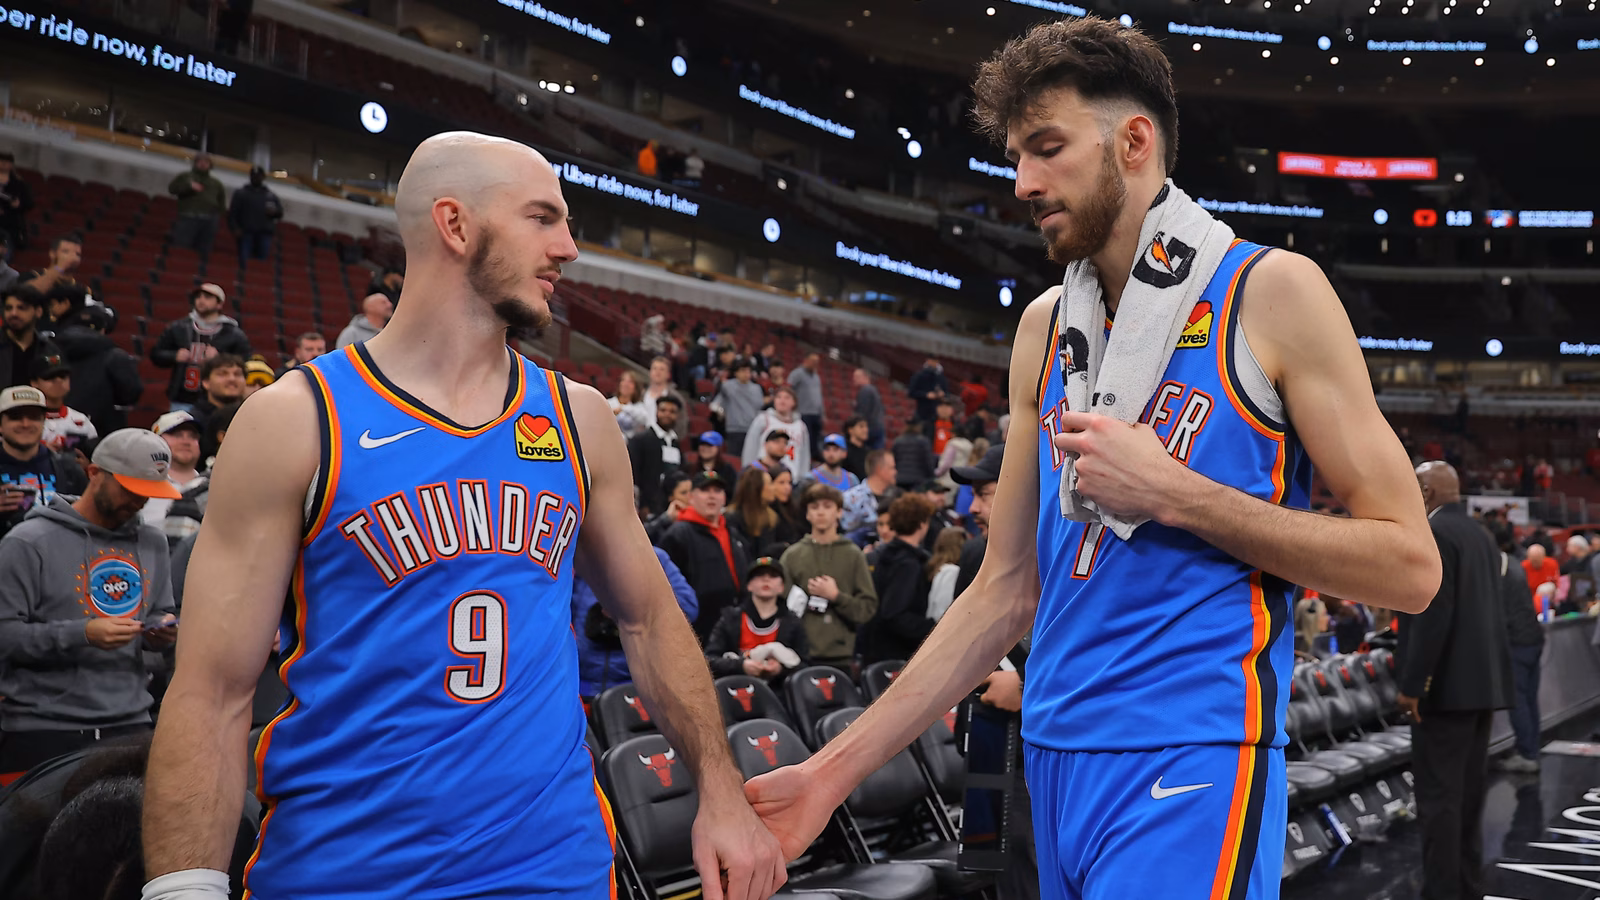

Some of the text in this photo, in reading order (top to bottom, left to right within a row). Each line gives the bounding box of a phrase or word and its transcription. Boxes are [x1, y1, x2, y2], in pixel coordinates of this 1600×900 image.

[524, 0, 547, 20] ride
[547, 10, 572, 31] now,
[572, 17, 586, 36] for
[587, 23, 611, 44] later
[40, 14, 89, 45] ride
[93, 32, 147, 66] now,
[152, 44, 184, 72] for
[186, 54, 236, 86] later
[564, 162, 597, 188] Uber
[598, 174, 624, 196] ride
[624, 184, 653, 206] now,
[654, 188, 670, 209] for
[672, 193, 699, 216] later
[1410, 338, 1433, 351] later
[1560, 342, 1584, 354] Book
[337, 478, 580, 588] THUNDER
[444, 589, 508, 704] 9
